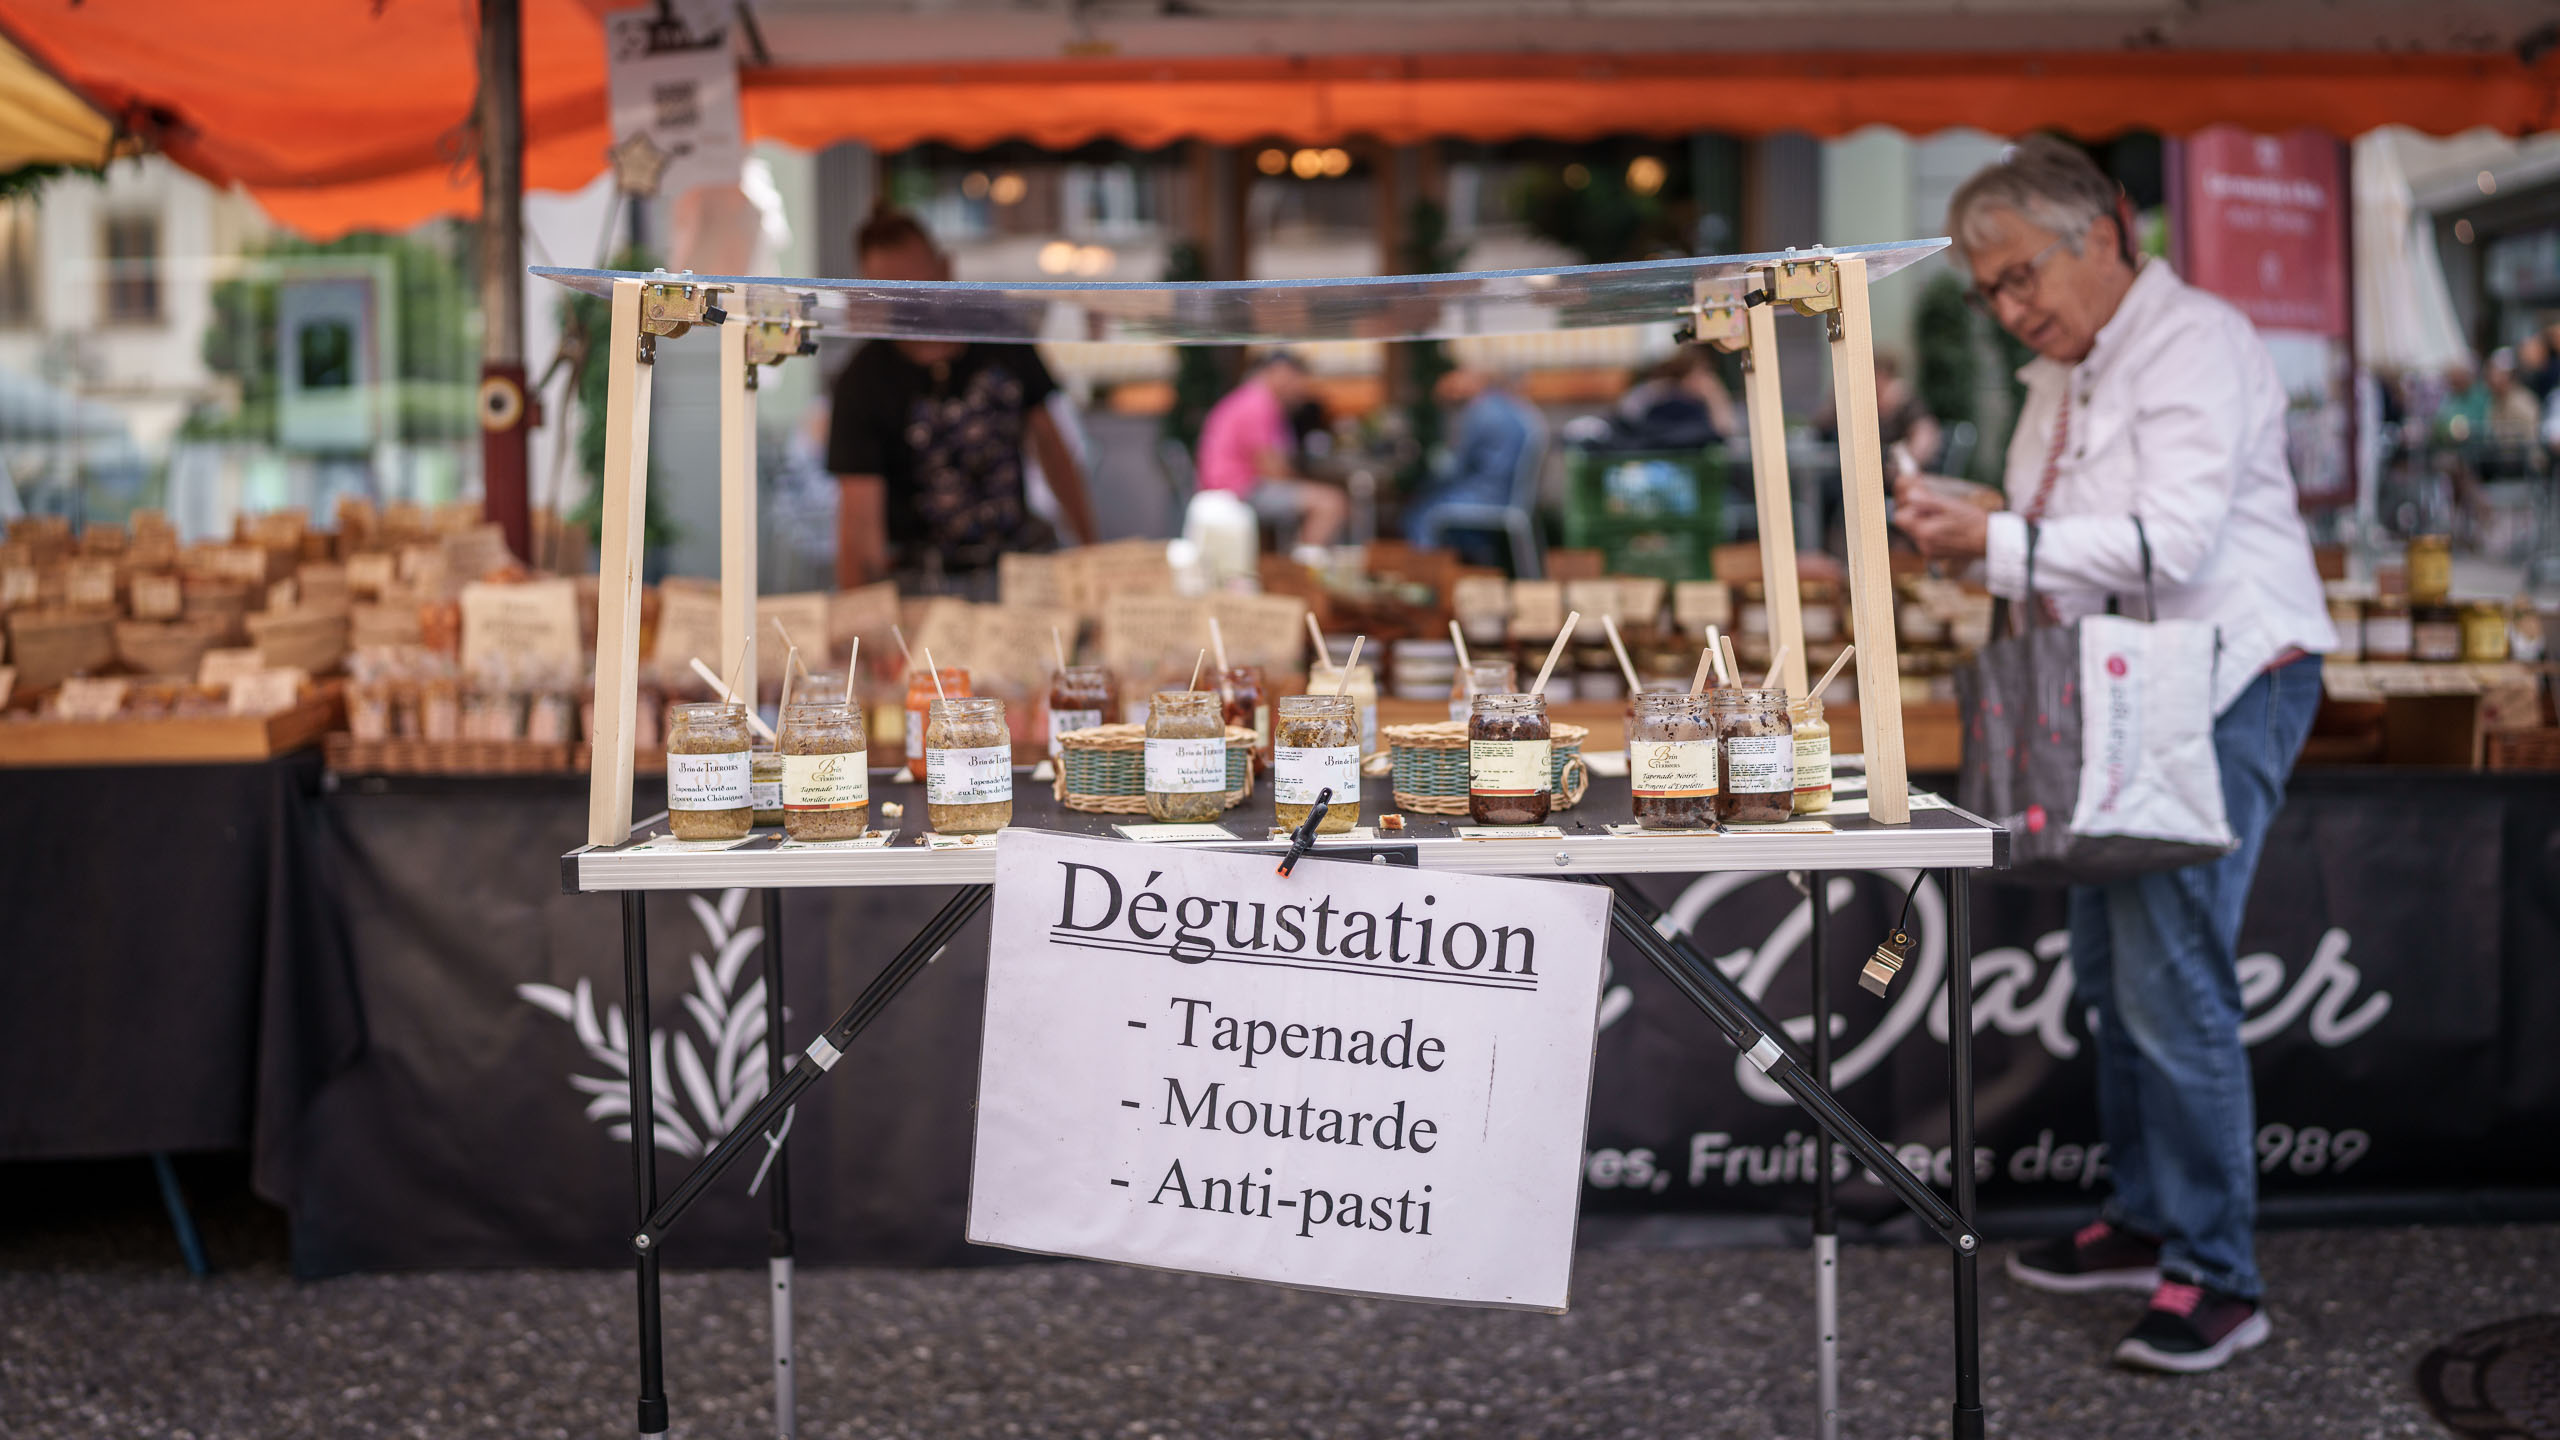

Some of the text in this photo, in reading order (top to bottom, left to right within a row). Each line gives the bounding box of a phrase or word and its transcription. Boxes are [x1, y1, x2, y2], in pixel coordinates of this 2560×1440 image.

[1056, 861, 1539, 976] Dégustation
[1170, 997, 1446, 1074] Tapenade
[1160, 1077, 1438, 1154] Moutarde
[2255, 1122, 2372, 1177] 989
[1149, 1158, 1433, 1238] Anti-pasti
